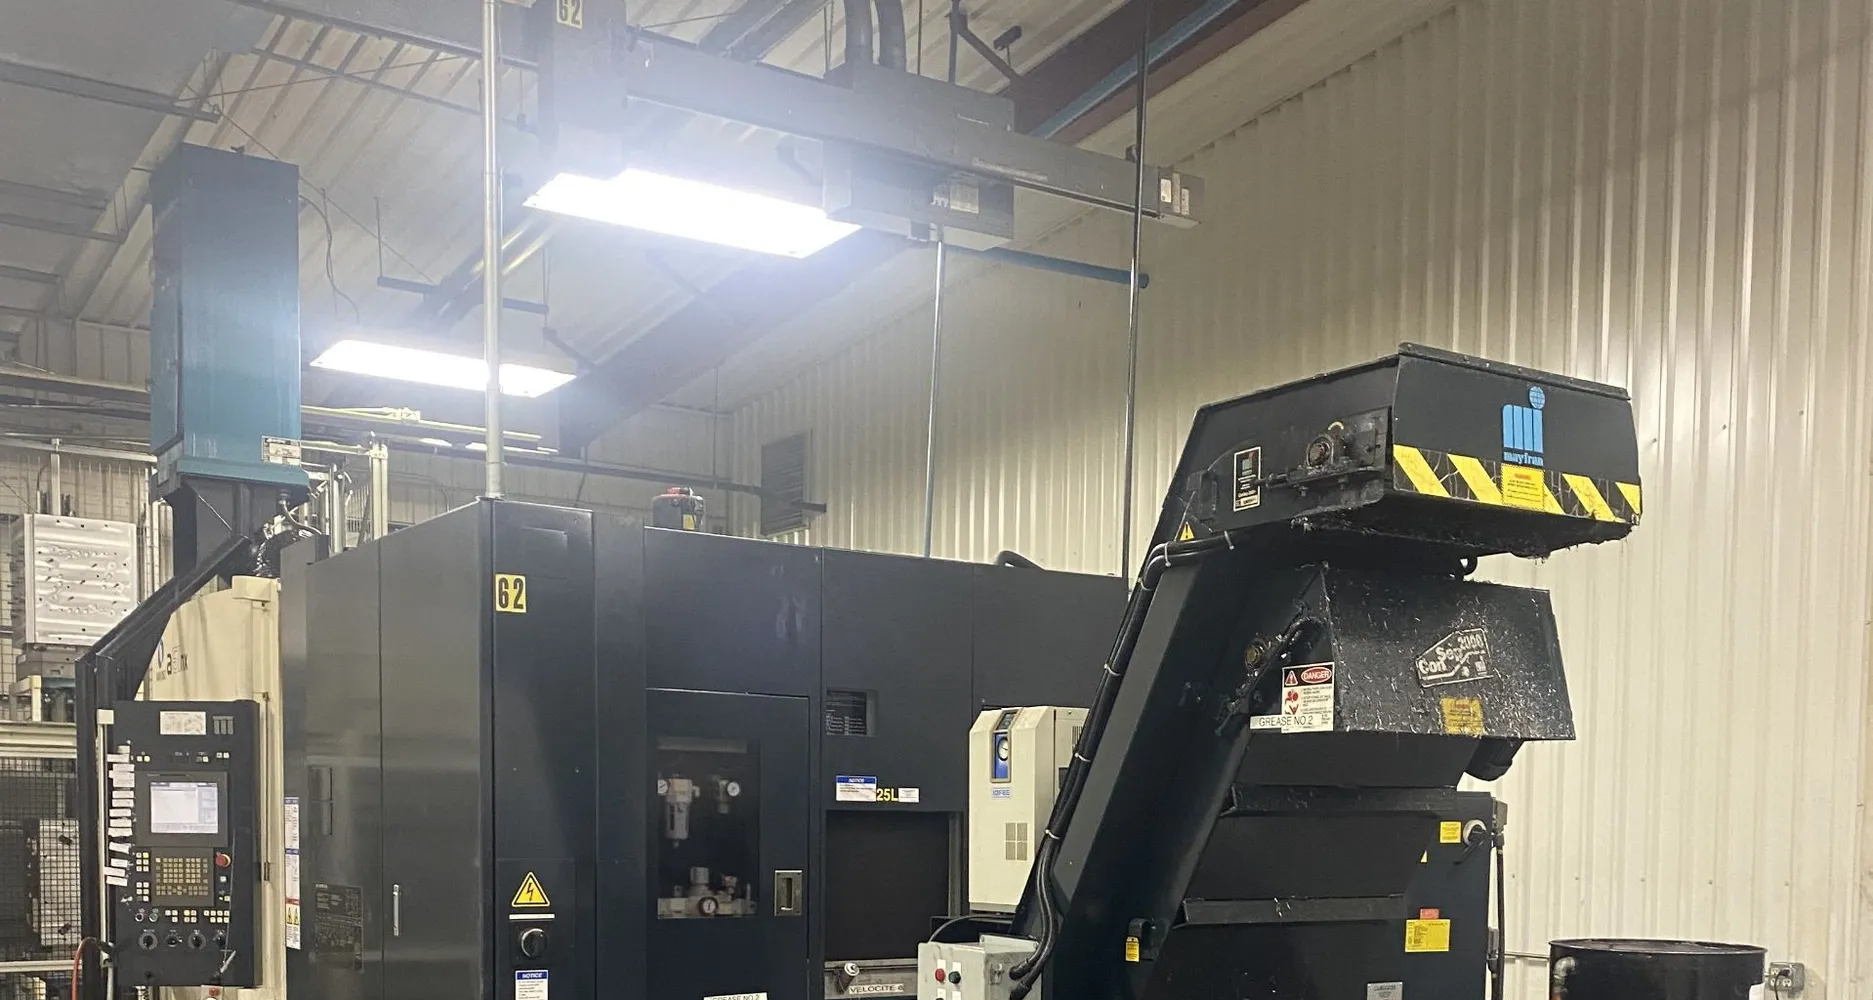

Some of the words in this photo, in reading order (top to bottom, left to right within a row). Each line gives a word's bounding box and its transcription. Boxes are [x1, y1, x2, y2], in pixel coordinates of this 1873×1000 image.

[559, 0, 580, 26] 62
[1503, 451, 1543, 467] mayfran
[498, 577, 524, 609] 62
[1303, 670, 1330, 680] DANGER
[1259, 716, 1292, 726] GREASE
[876, 788, 898, 801] 25L
[850, 985, 896, 993] VELOCITE
